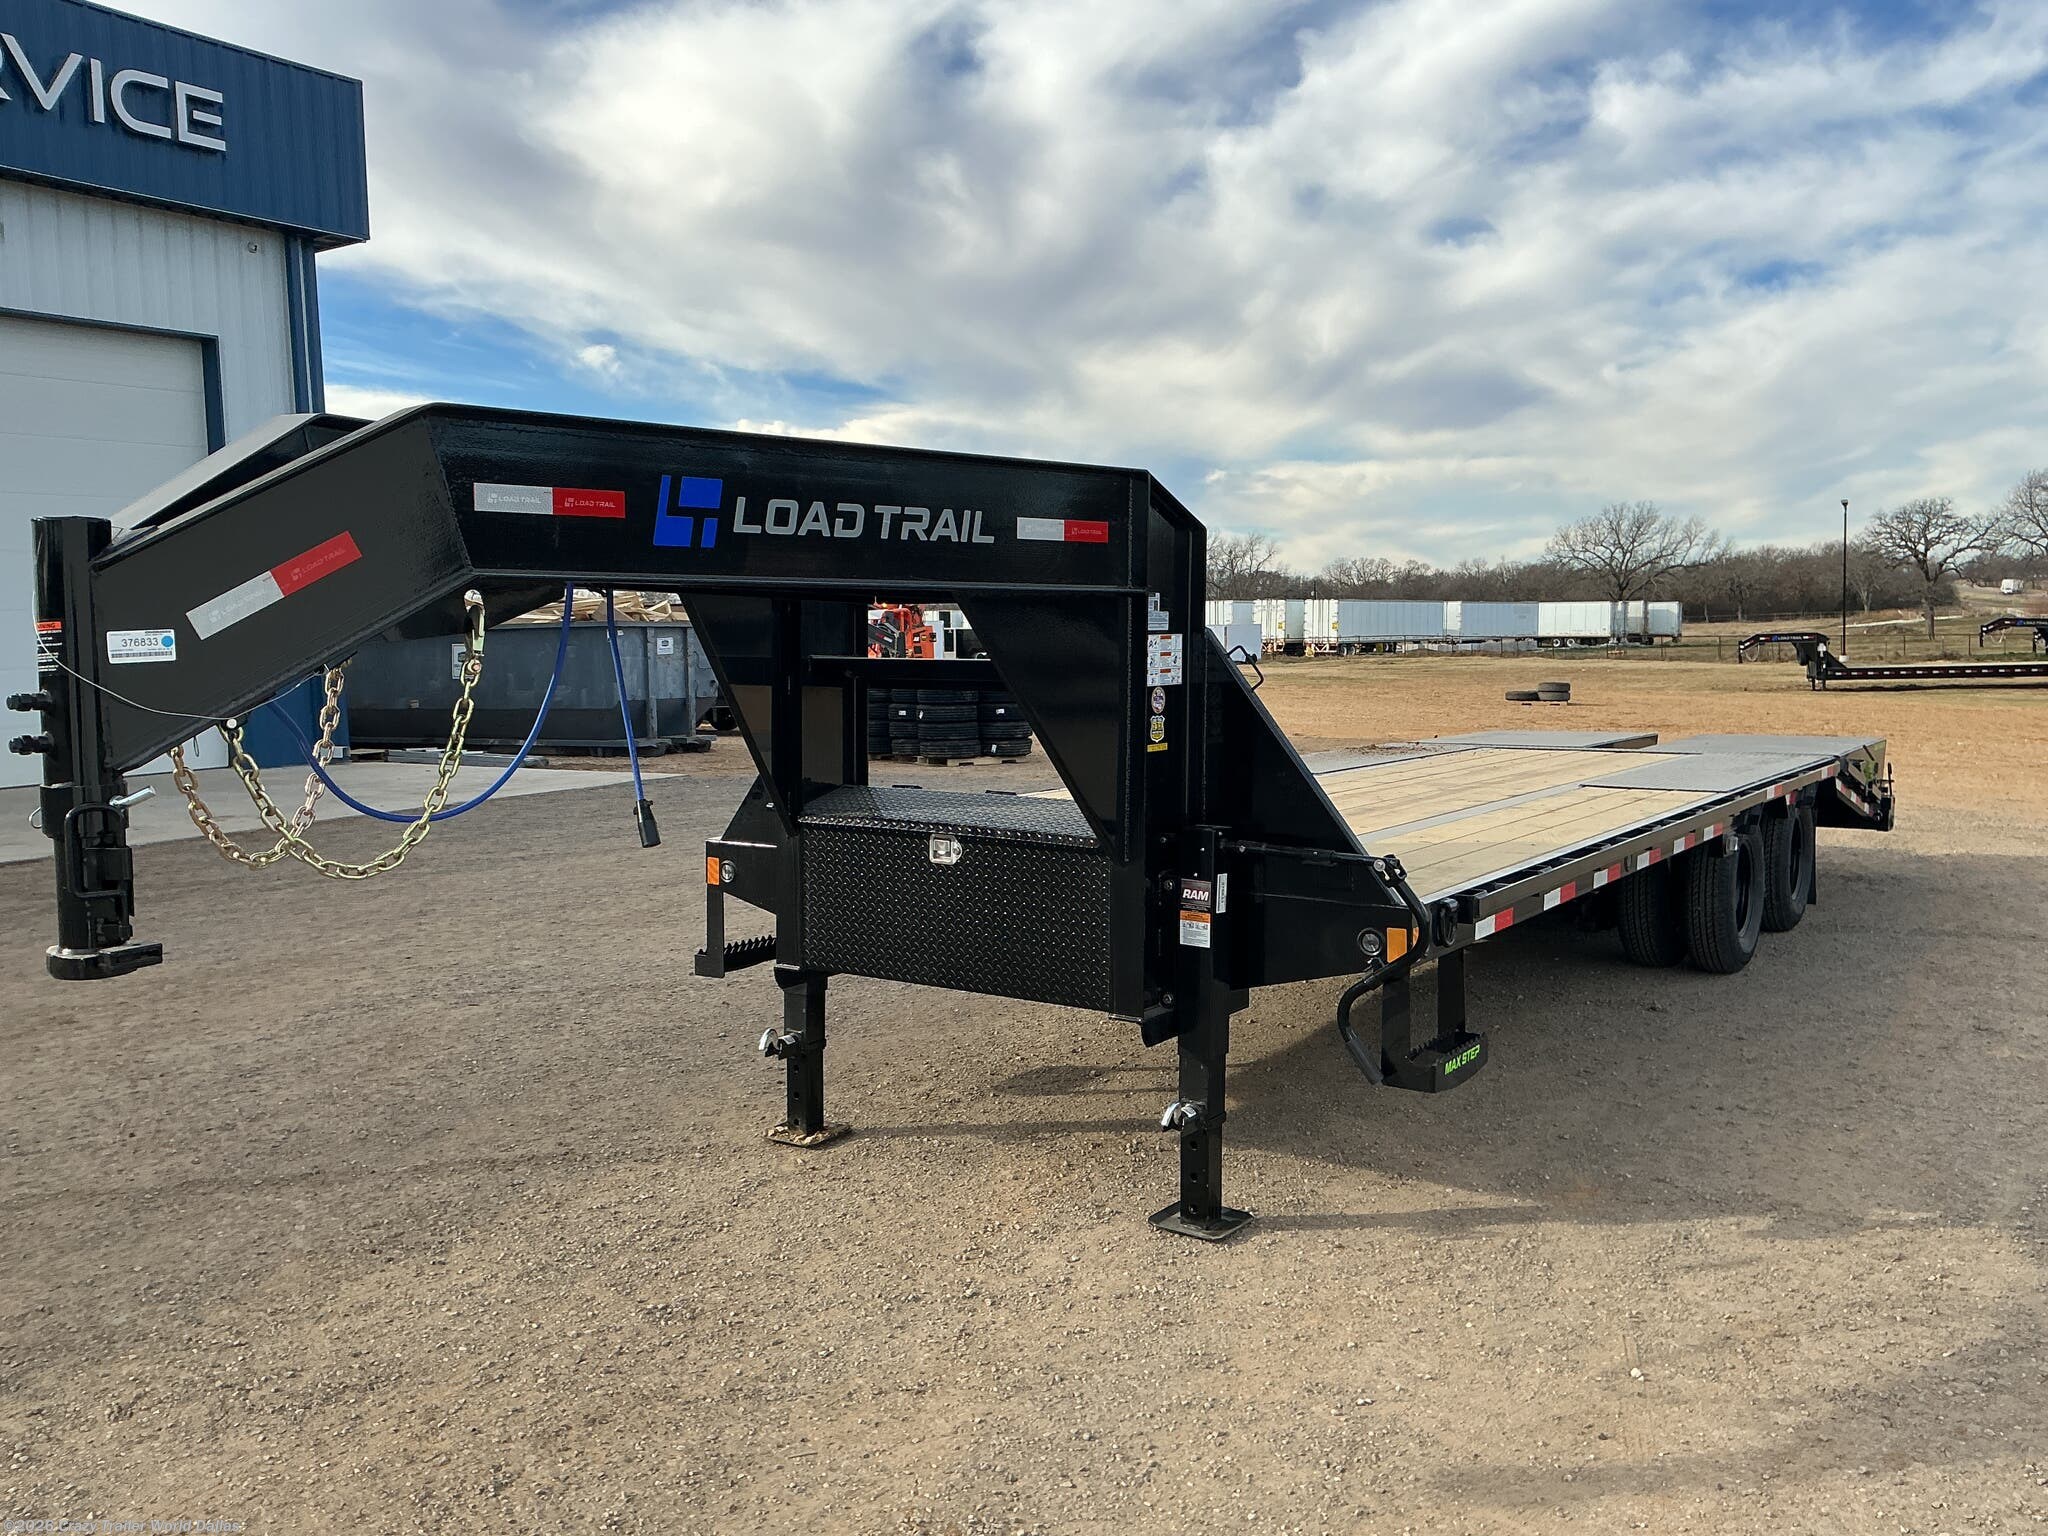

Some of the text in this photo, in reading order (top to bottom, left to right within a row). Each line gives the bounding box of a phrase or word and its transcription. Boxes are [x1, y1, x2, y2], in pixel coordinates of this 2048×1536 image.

[574, 499, 616, 508] LOAD TRAIL
[733, 496, 995, 543] LOAD TRAIL
[121, 637, 159, 648] 376833
[1182, 888, 1209, 901] RAM
[1444, 1044, 1480, 1075] MAX STEP
